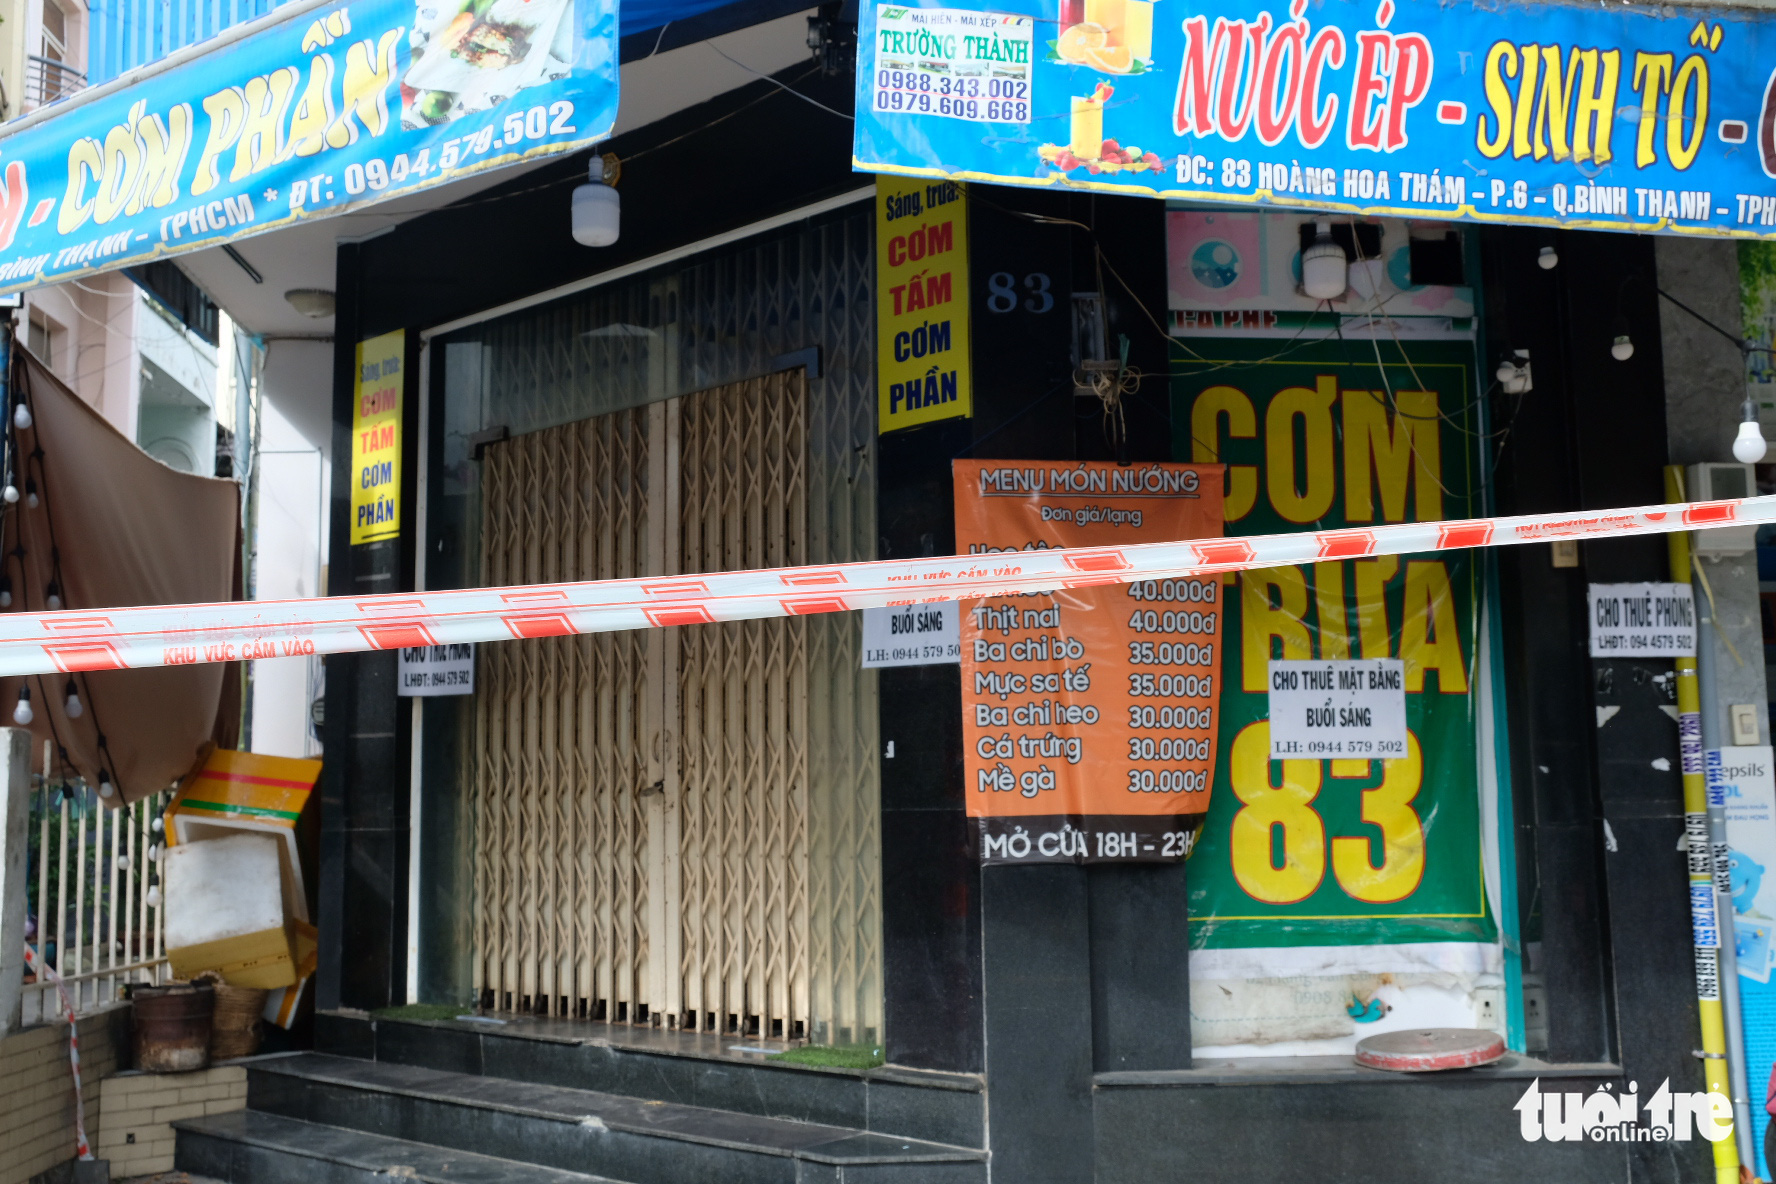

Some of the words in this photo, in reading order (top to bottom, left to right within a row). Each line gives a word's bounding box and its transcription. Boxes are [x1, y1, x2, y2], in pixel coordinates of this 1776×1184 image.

[980, 12, 997, 28] XẾP
[880, 27, 957, 59] TRƯỜNG
[963, 31, 1029, 63] THÀNH
[878, 70, 1028, 99] 0988.343.002
[1174, 0, 1346, 149] NƯỚC
[1346, 0, 1434, 153] ÉP
[1437, 100, 1466, 125] -
[1476, 40, 1620, 168] SINH
[57, 98, 193, 234] CƠM
[191, 8, 405, 195] PHẦN
[877, 90, 1027, 121] 0979.609.668
[53, 229, 134, 268] THẠNH
[160, 193, 254, 242] TPHCM
[289, 174, 334, 210] ĐT:
[344, 100, 577, 196] 0944.579.502
[1176, 154, 1214, 187] ĐC:
[1221, 157, 1251, 188] 83
[1257, 160, 1337, 197] HOÀNG
[1343, 170, 1391, 200] HOA
[1399, 167, 1466, 205] THÁM
[1490, 179, 1527, 209] P.6
[1552, 176, 1627, 217] Q.BÌNH
[1635, 188, 1710, 226] THẠNH
[1736, 194, 1776, 228] TPH
[886, 189, 924, 222] Sáng,
[888, 220, 953, 268] CƠM
[889, 269, 952, 316] TẤM
[986, 271, 1055, 314] 83
[894, 320, 951, 363] CƠM
[361, 386, 396, 418] CƠM
[889, 365, 958, 415] PHẦN
[360, 422, 395, 454] TẤM
[1191, 374, 1443, 524] CƠM
[361, 460, 392, 489] CƠM
[980, 468, 1045, 492] MENU
[1050, 463, 1107, 492] MÓN
[1111, 463, 1200, 493] NƯỚNG
[358, 494, 395, 528] PHẦN
[1040, 505, 1072, 523] Đơn
[1075, 505, 1143, 528] giá/lạng
[1127, 578, 1217, 603] 40.000đ
[917, 606, 943, 632] SÁNG
[971, 604, 1019, 636] Thịt
[1022, 603, 1061, 630] nai
[1128, 609, 1217, 635] 40.000đ
[1224, 556, 1469, 694] RƯA
[1596, 598, 1619, 627] CHO
[163, 647, 197, 665] KHU
[241, 637, 277, 660] CẤM
[281, 635, 315, 656] VÀO
[866, 650, 890, 662] LH:
[892, 649, 919, 661] 0944
[923, 646, 943, 658] 579
[947, 645, 960, 656] 50
[973, 638, 1006, 663] Ba
[1010, 635, 1048, 662] chỉ
[1052, 635, 1085, 661] bò
[1128, 641, 1214, 666] 35.000đ
[1630, 635, 1648, 649] 094
[1650, 635, 1674, 649] 4579
[973, 671, 1027, 701] Mực
[1030, 672, 1060, 694] sa
[1062, 663, 1091, 692] tế
[1128, 673, 1213, 698] 35.000đ
[1272, 670, 1298, 690] CHO
[1302, 665, 1335, 690] THUÊ
[1338, 666, 1364, 695] MẶT
[1369, 662, 1400, 690] BẰNG
[975, 703, 1008, 727] Ba
[1012, 699, 1051, 727] chỉ
[1054, 700, 1100, 726] heo
[1127, 705, 1212, 729] 30.000đ
[1306, 698, 1336, 727] BUỔI
[1339, 702, 1372, 727] SÁNG
[976, 733, 1014, 759] Cá
[1017, 733, 1083, 765] trứng
[1127, 737, 1211, 761] 30.000đ
[1275, 742, 1303, 754] LH:
[1308, 741, 1342, 753] 0944
[1348, 741, 1373, 753] 579
[1378, 741, 1403, 753] 502
[977, 762, 1016, 793] Mề
[1020, 764, 1056, 799] gà
[1127, 769, 1208, 794] 30.000đ
[1722, 763, 1766, 781] epsils
[1230, 718, 1426, 904] 83
[984, 825, 1032, 858] MỞ
[1037, 824, 1089, 858] CỬA
[1096, 832, 1137, 858] 18H
[1160, 831, 1196, 857] 23H
